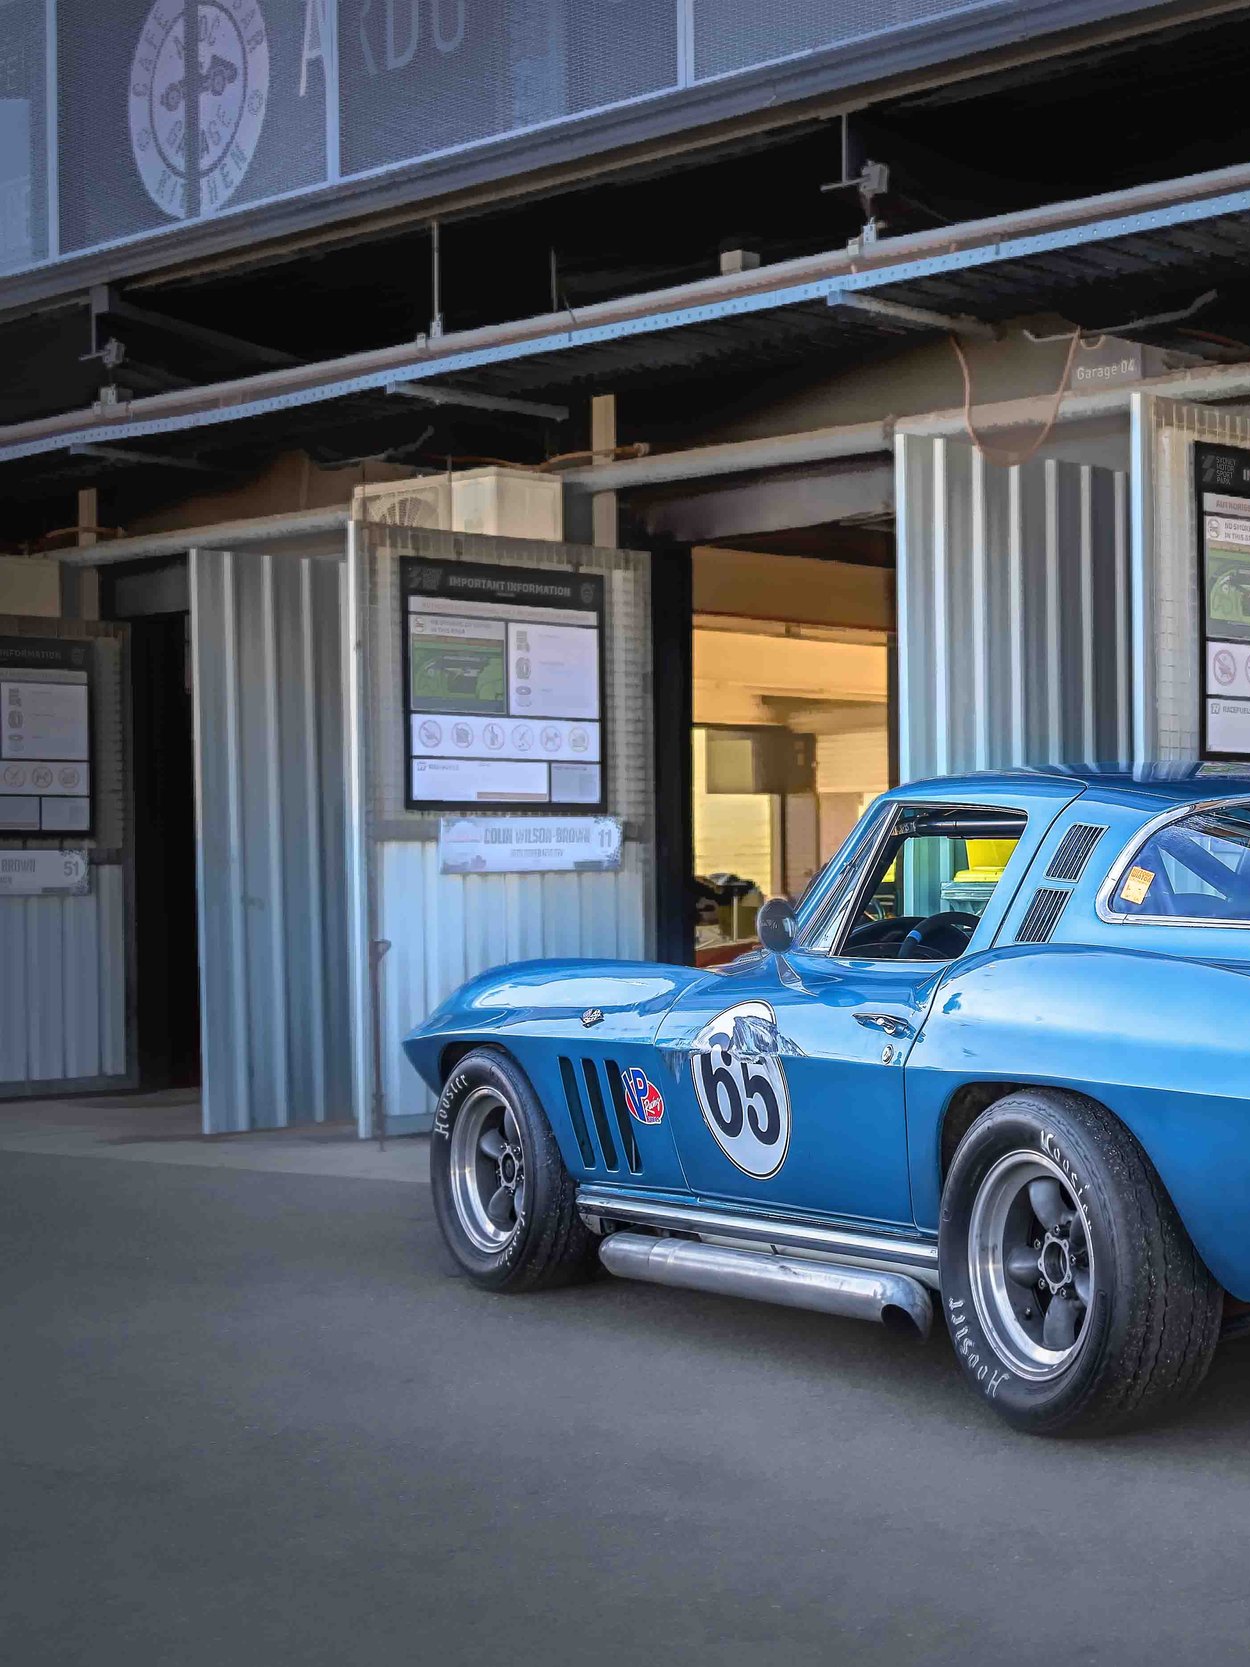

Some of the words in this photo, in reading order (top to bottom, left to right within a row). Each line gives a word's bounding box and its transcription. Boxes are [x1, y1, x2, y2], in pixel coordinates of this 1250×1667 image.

[1077, 363, 1118, 380] Garage
[1121, 359, 1135, 374] 04
[1216, 470, 1233, 479] SPORT
[1224, 522, 1233, 530] NO
[1232, 532, 1244, 541] THIS
[449, 576, 506, 592] IMPORTANT
[506, 582, 571, 597] INFORMATION
[484, 828, 513, 844] COLIN
[598, 829, 612, 848] 11
[1, 859, 36, 873] BROWN
[63, 861, 79, 877] 51
[621, 1068, 649, 1122] VP
[701, 1032, 781, 1146] 65
[949, 1296, 1010, 1399] Hoosier
